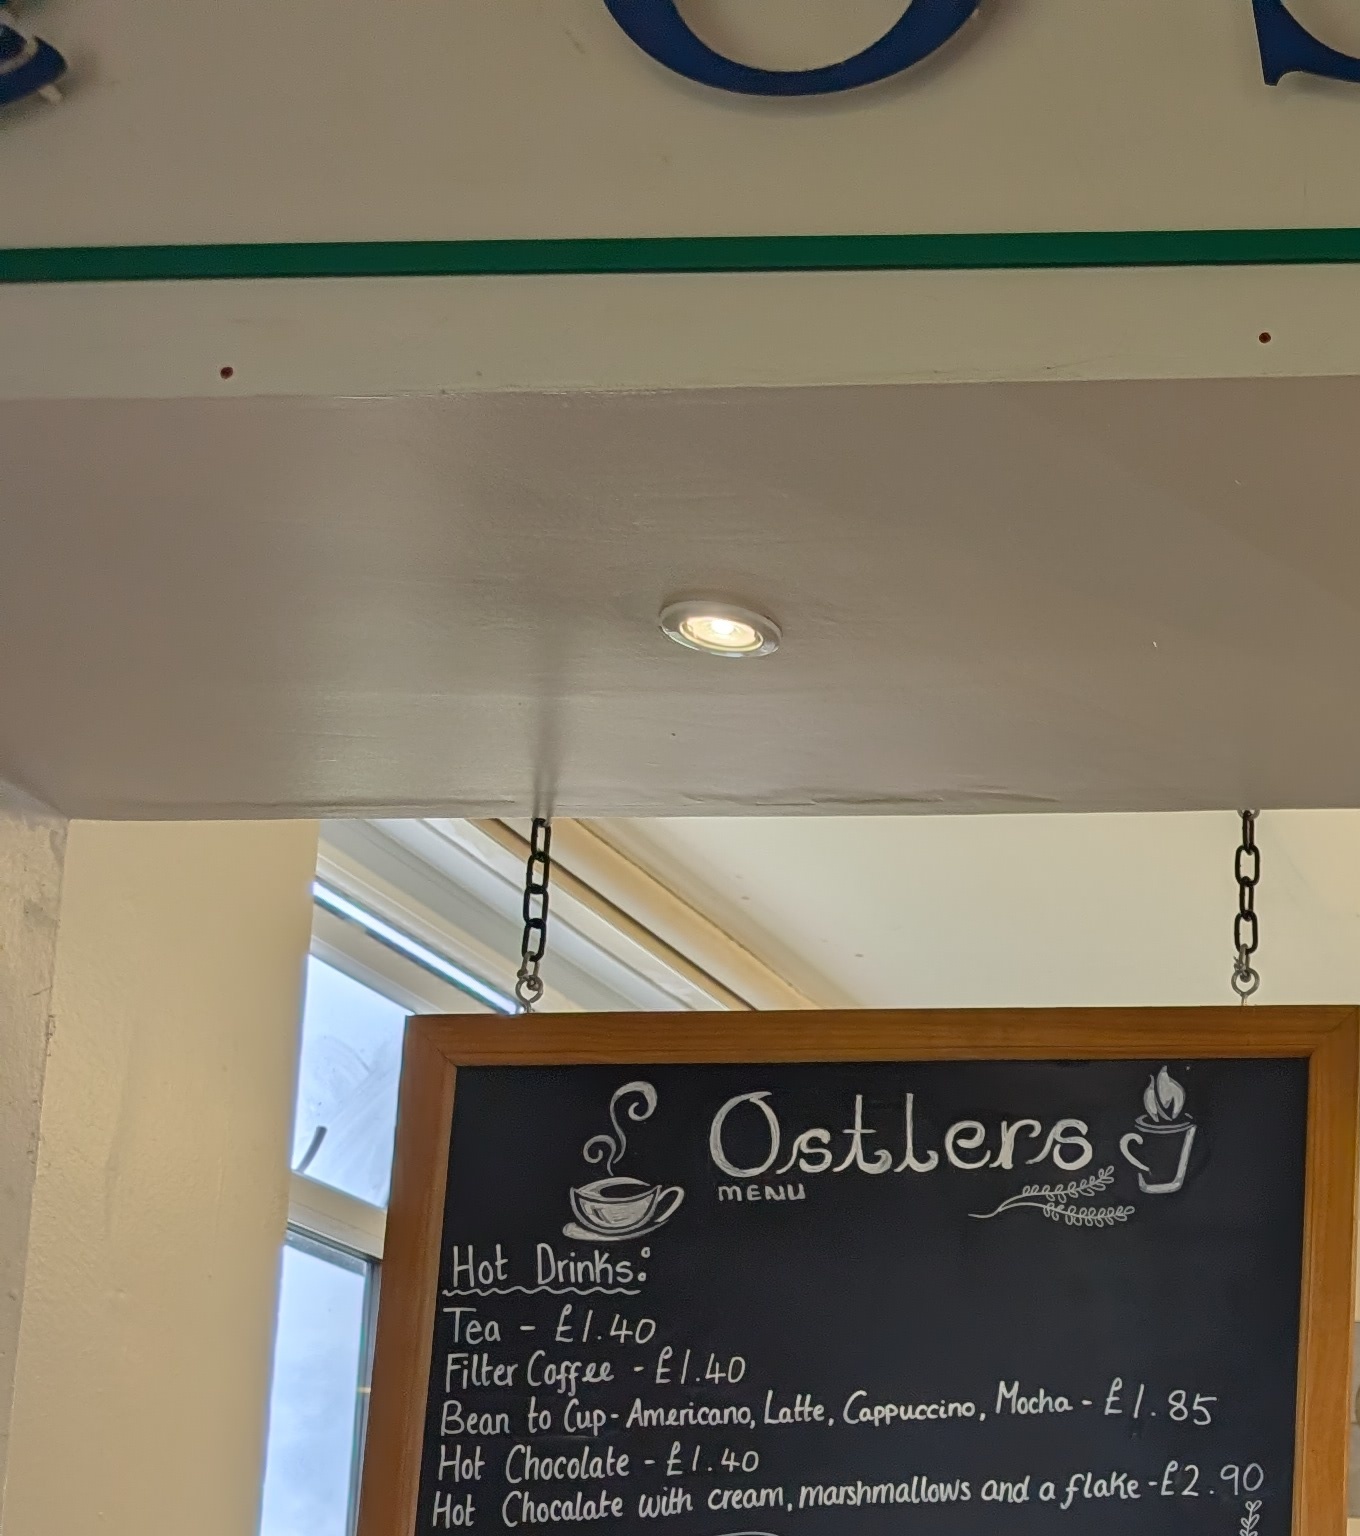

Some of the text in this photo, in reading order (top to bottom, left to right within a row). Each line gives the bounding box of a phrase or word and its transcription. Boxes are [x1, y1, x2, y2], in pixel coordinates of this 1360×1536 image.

[709, 1091, 1093, 1178] Ostlers
[718, 1183, 806, 1201] MENU
[454, 1244, 507, 1287] Hot
[443, 1304, 655, 1344] Tea £1.40
[445, 1346, 746, 1396] Filter Coffee £1.40
[440, 1400, 509, 1436] Bean
[527, 1395, 551, 1432] to
[996, 1380, 1072, 1418] Mocha
[1104, 1377, 1217, 1426] £1.85
[438, 1441, 760, 1484] Hot Chocolate £1.40
[433, 1491, 475, 1528] Hot
[639, 1487, 692, 1519] with
[799, 1475, 971, 1508] marshmallows
[981, 1475, 1029, 1502] and
[1039, 1481, 1056, 1499] a
[1061, 1473, 1141, 1509] flake
